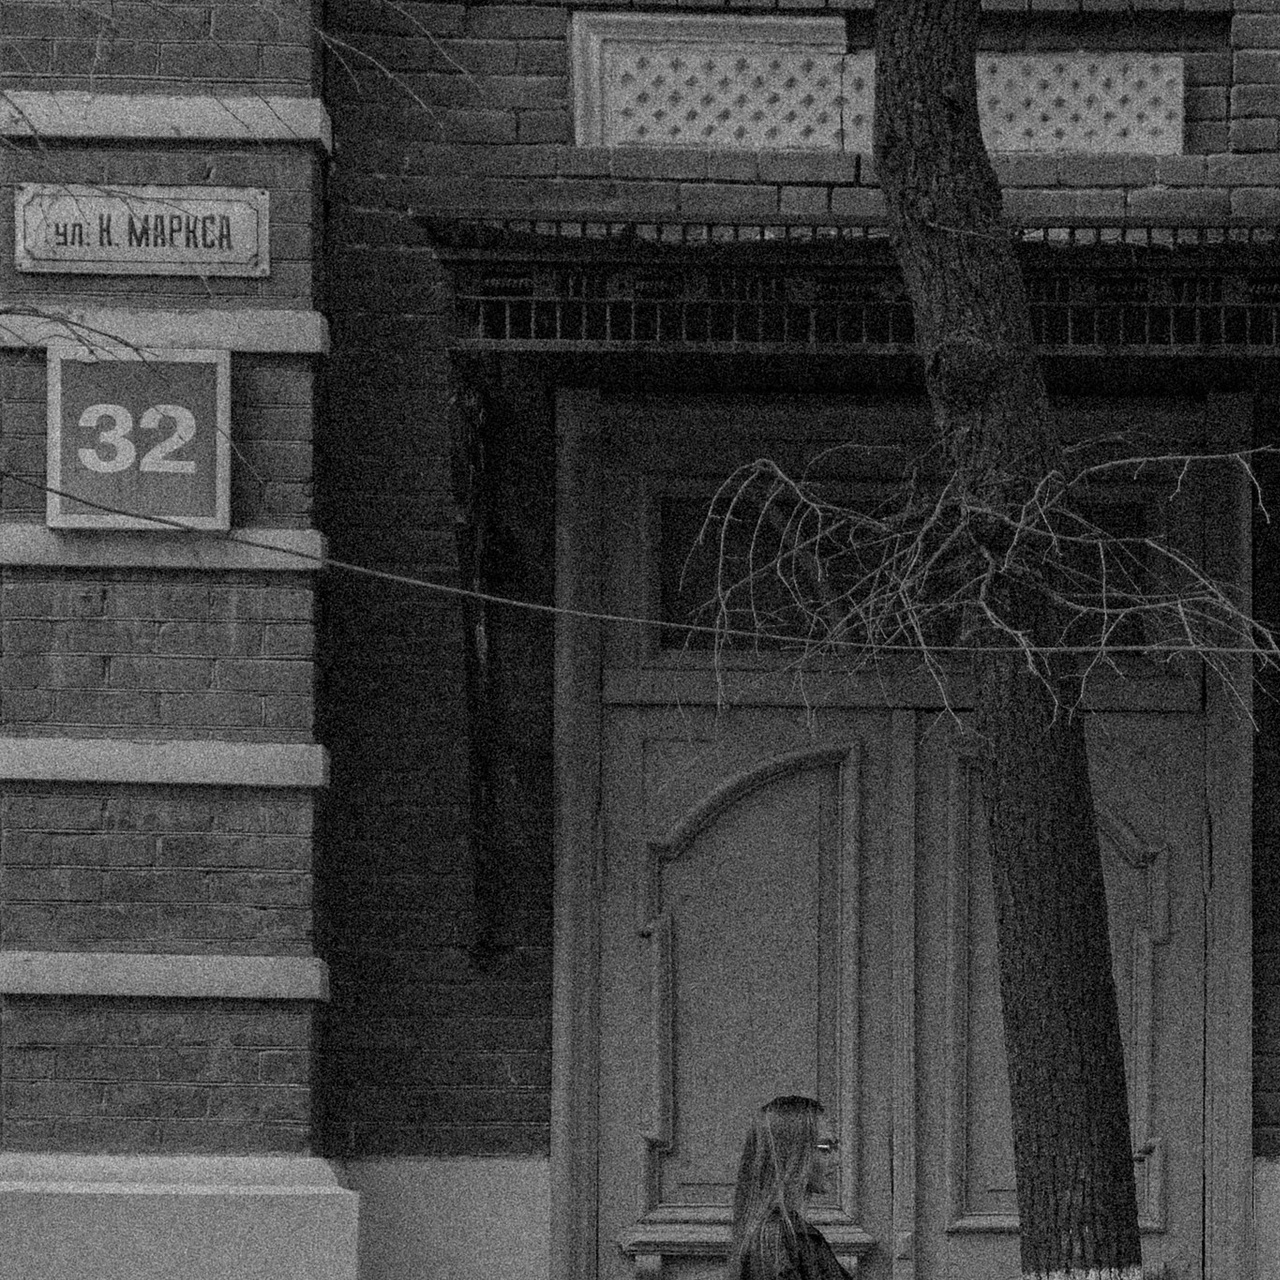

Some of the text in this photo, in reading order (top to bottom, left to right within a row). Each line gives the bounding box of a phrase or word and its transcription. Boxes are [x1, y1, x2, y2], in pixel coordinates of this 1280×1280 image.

[99, 213, 119, 248] К.
[128, 213, 232, 251] МАРКСА
[78, 403, 196, 472] 32
